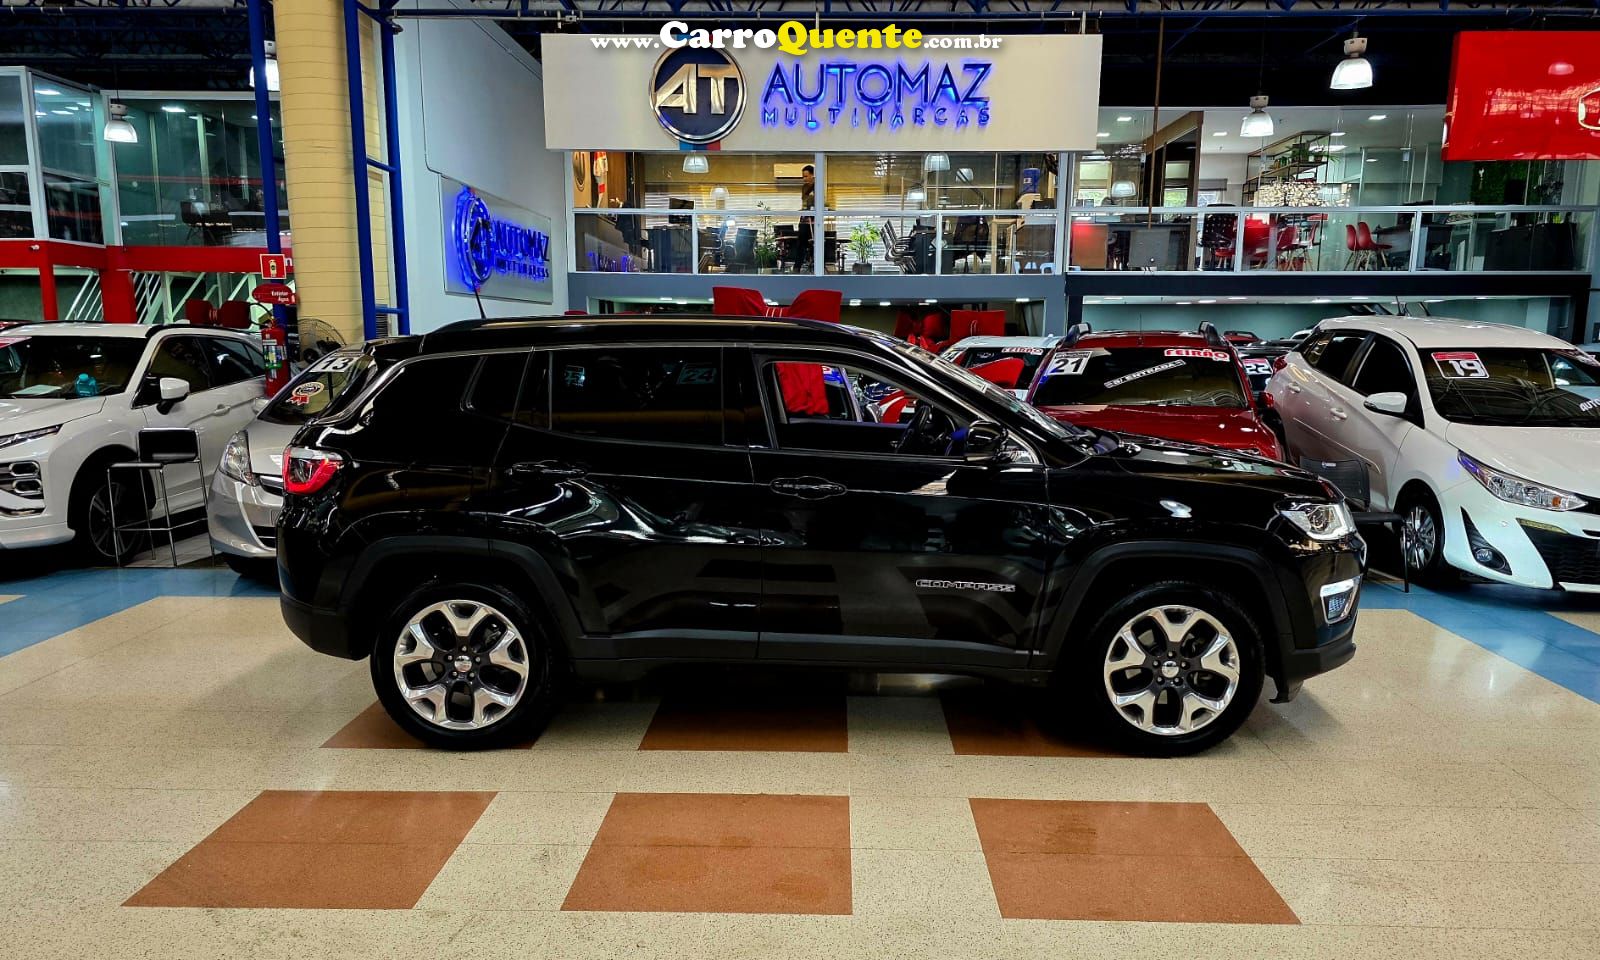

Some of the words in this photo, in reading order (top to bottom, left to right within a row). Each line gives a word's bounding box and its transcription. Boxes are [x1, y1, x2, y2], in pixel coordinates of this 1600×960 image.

[654, 63, 740, 115] AT
[763, 61, 993, 106] AUTOMAZ
[762, 106, 991, 128] MULTIMARCAS
[321, 357, 354, 371] 13
[1050, 358, 1084, 373] 21
[1448, 360, 1486, 377] 19
[915, 579, 1016, 592] COMPASS
